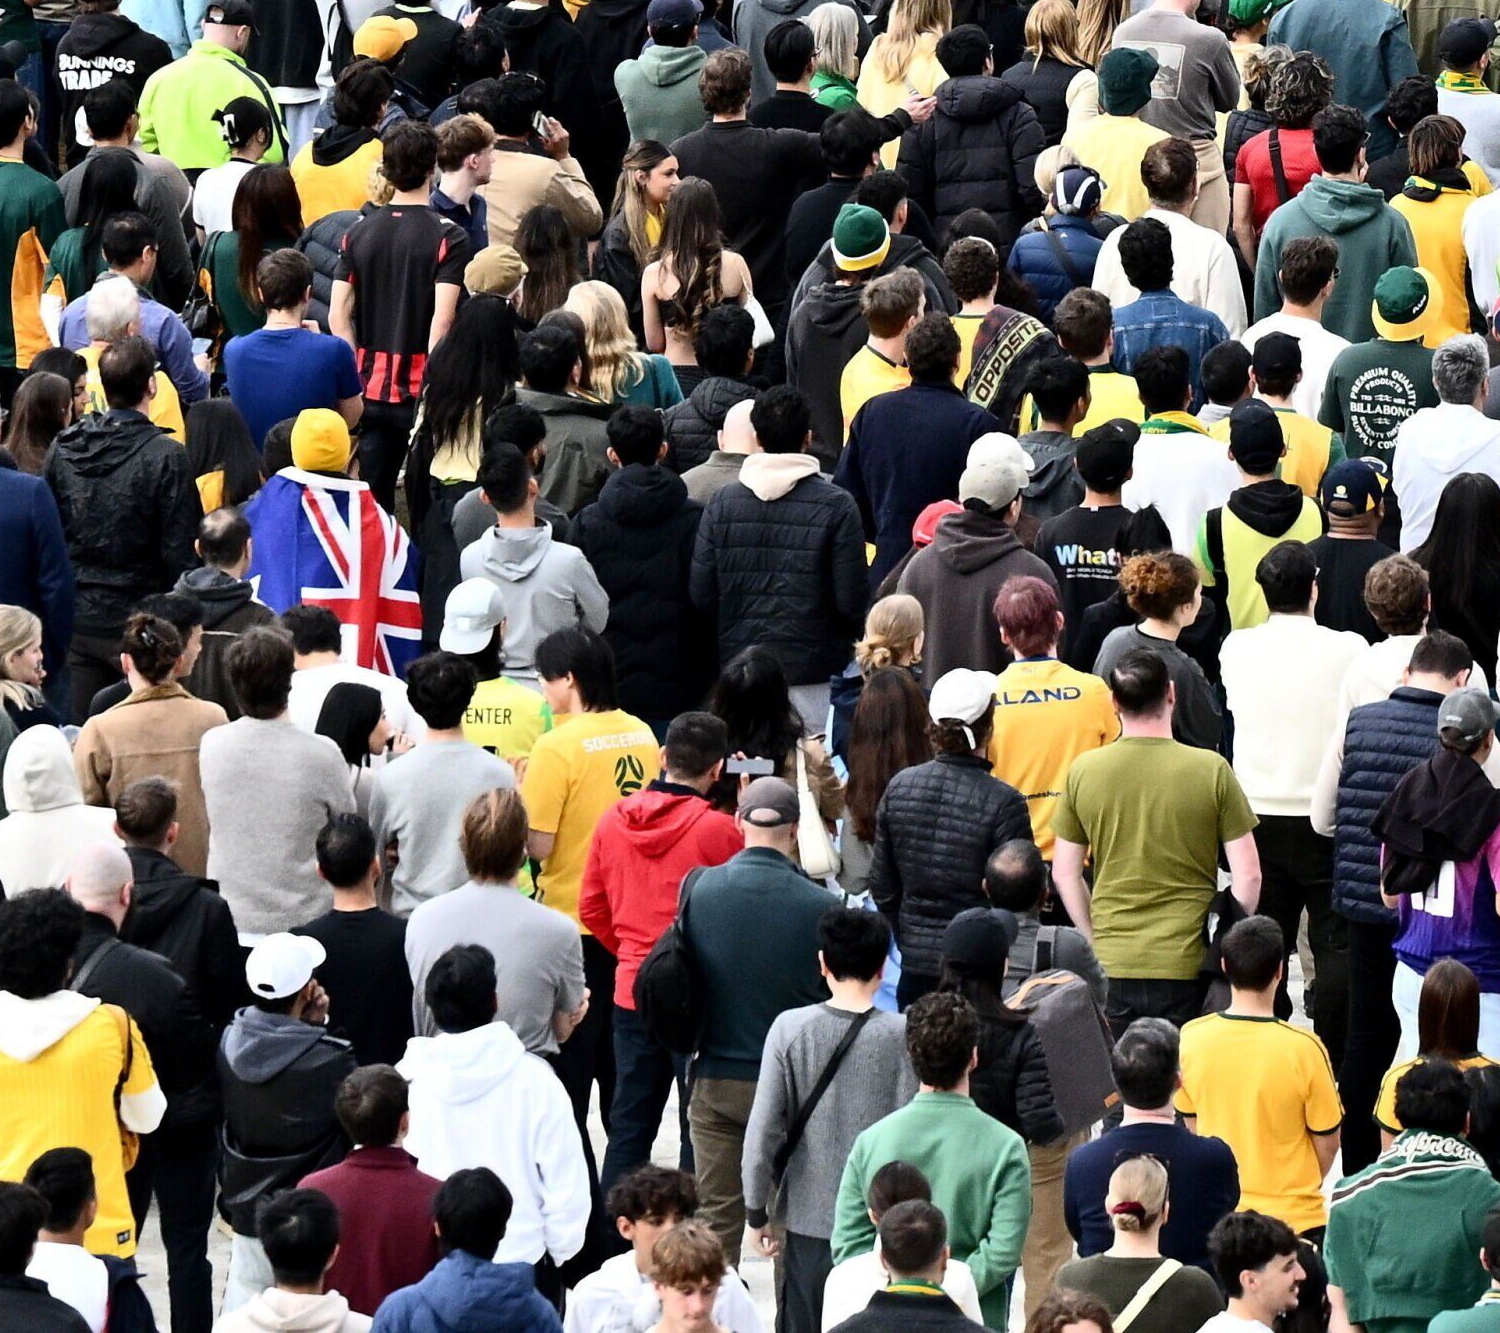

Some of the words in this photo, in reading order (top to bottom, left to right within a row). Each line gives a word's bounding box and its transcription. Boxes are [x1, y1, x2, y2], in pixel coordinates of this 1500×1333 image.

[59, 53, 136, 75] BUNNINGS
[60, 70, 113, 91] TRADE
[973, 318, 1045, 404] OPPOSITE
[1350, 367, 1388, 400] PREMIUM
[1390, 369, 1417, 407] QUALITY
[1350, 403, 1414, 417] BILLABONG
